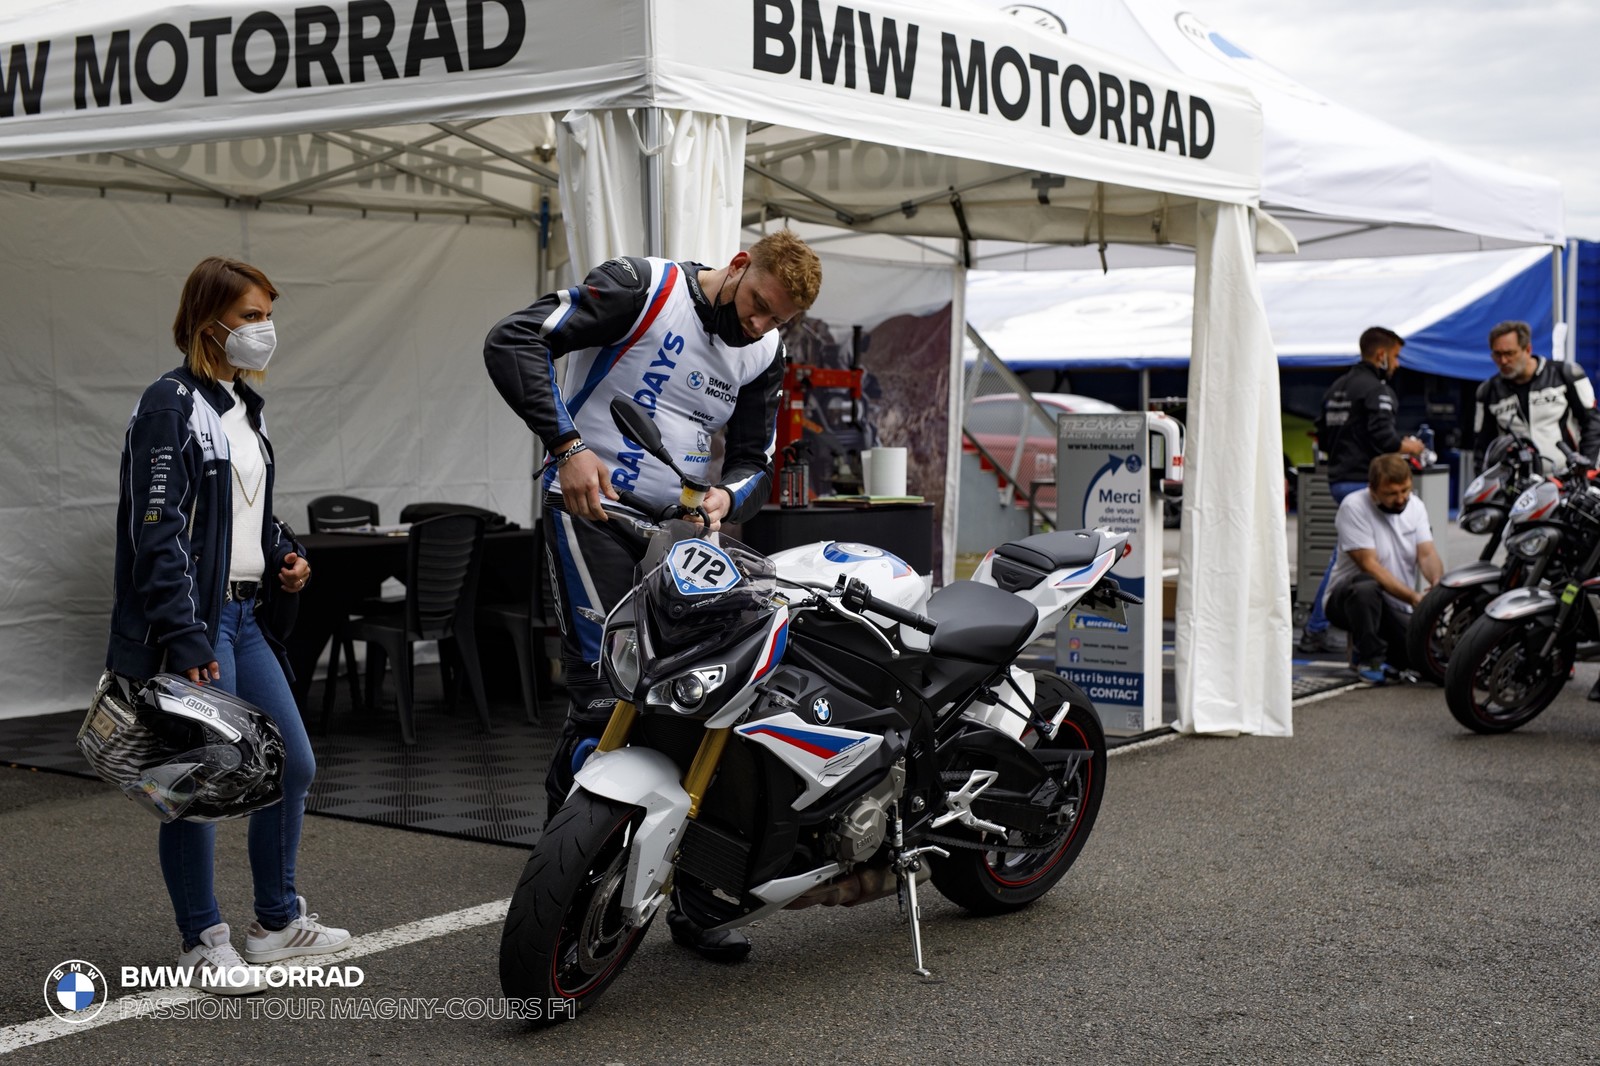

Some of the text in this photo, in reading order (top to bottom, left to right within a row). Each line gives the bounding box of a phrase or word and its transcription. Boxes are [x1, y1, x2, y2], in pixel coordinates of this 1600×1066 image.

[75, 0, 526, 110] MOTORRAD
[753, 0, 1215, 159] BMW MOTORRAD
[708, 376, 733, 391] BMW
[693, 410, 715, 422] MAKE
[1061, 418, 1142, 432] TECMAS
[1067, 443, 1135, 451] www.tecmas.net
[1099, 489, 1141, 504] Merci
[682, 546, 726, 586] 172
[1060, 670, 1139, 686] Distributeur
[1089, 687, 1138, 700] CONTACT
[186, 697, 215, 717] SHOEI
